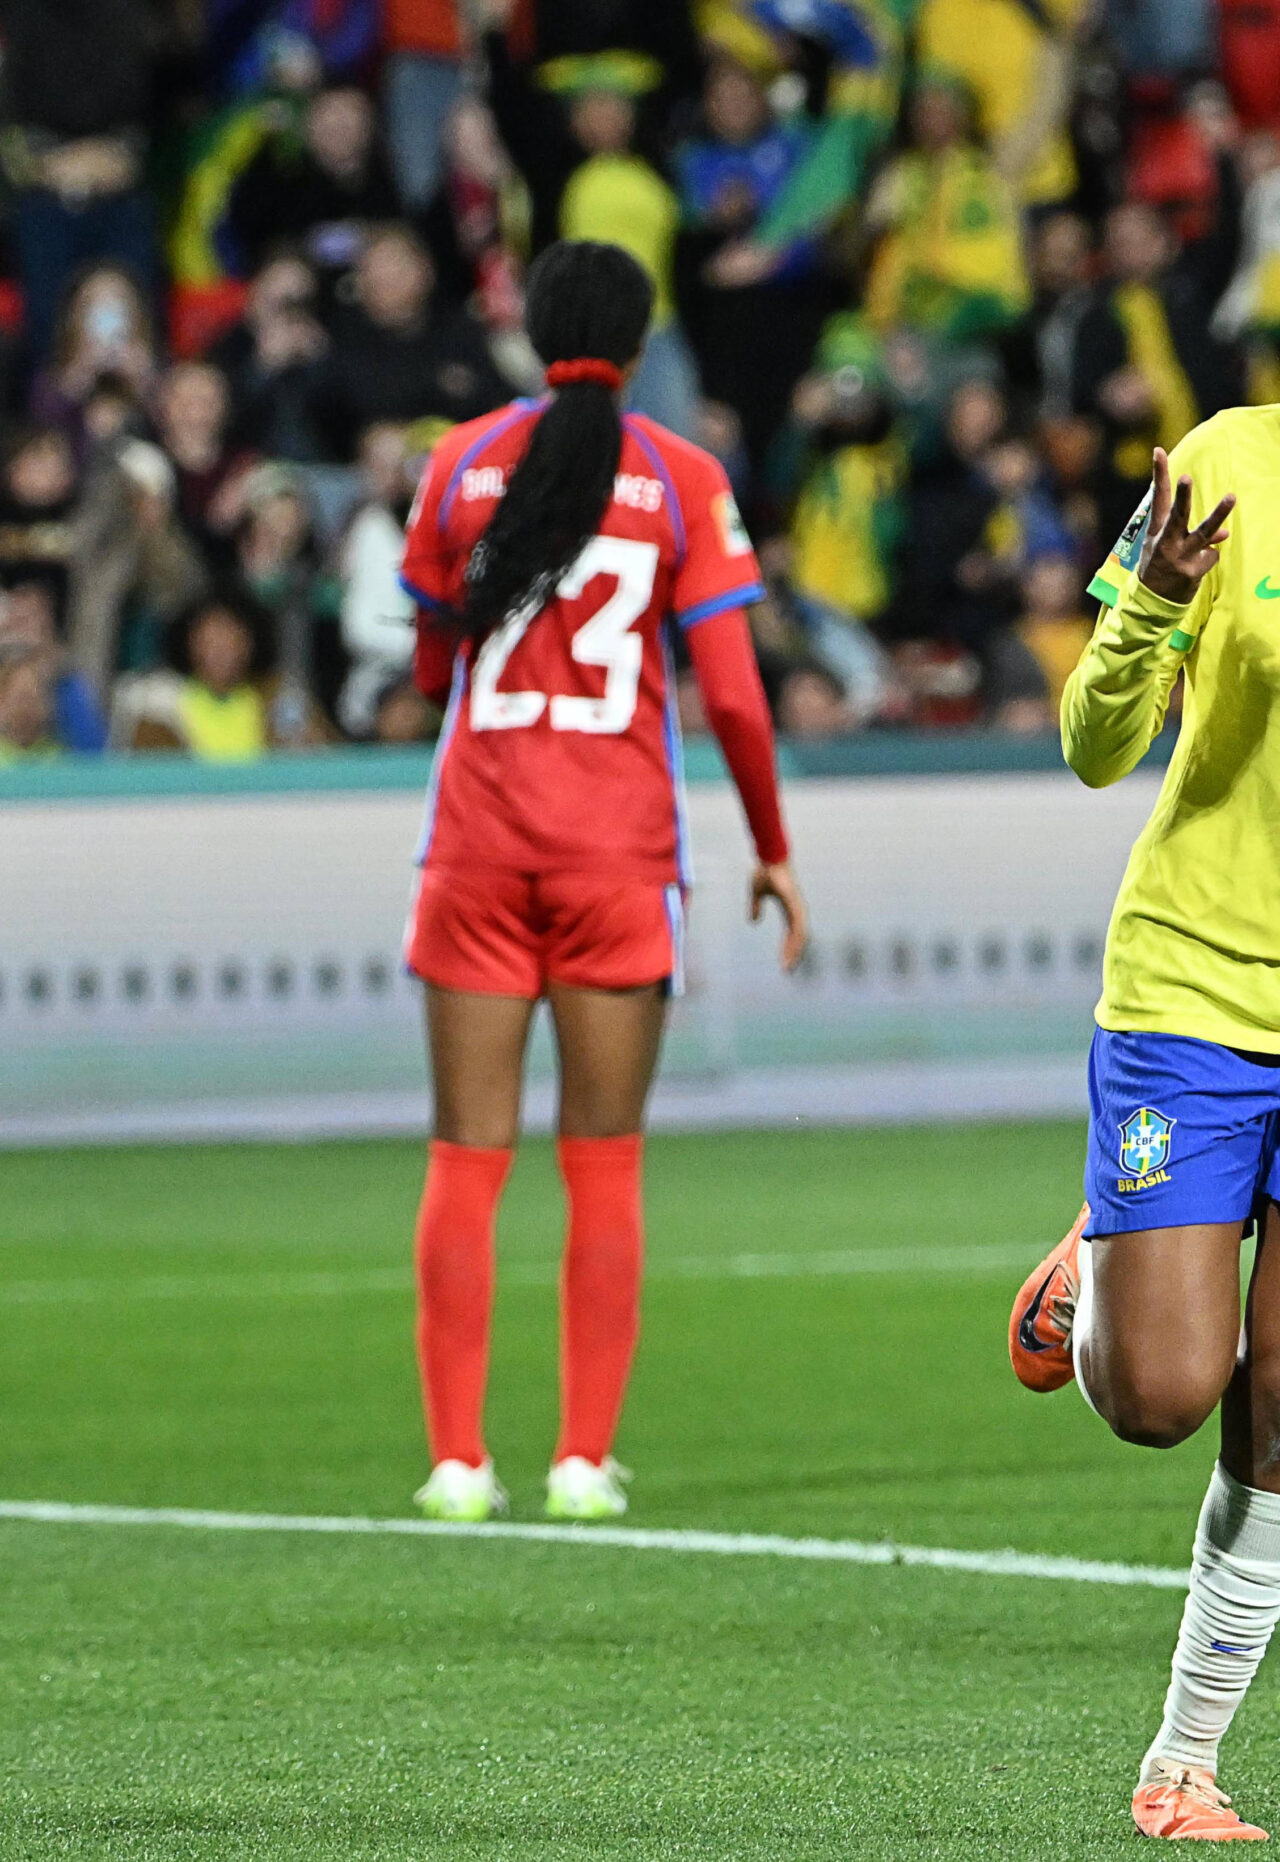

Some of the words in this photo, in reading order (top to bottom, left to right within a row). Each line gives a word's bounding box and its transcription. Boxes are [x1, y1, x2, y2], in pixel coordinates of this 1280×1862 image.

[469, 534, 661, 735] 23
[1135, 1136, 1155, 1146] CBF
[1117, 1169, 1172, 1192] BRASIL
